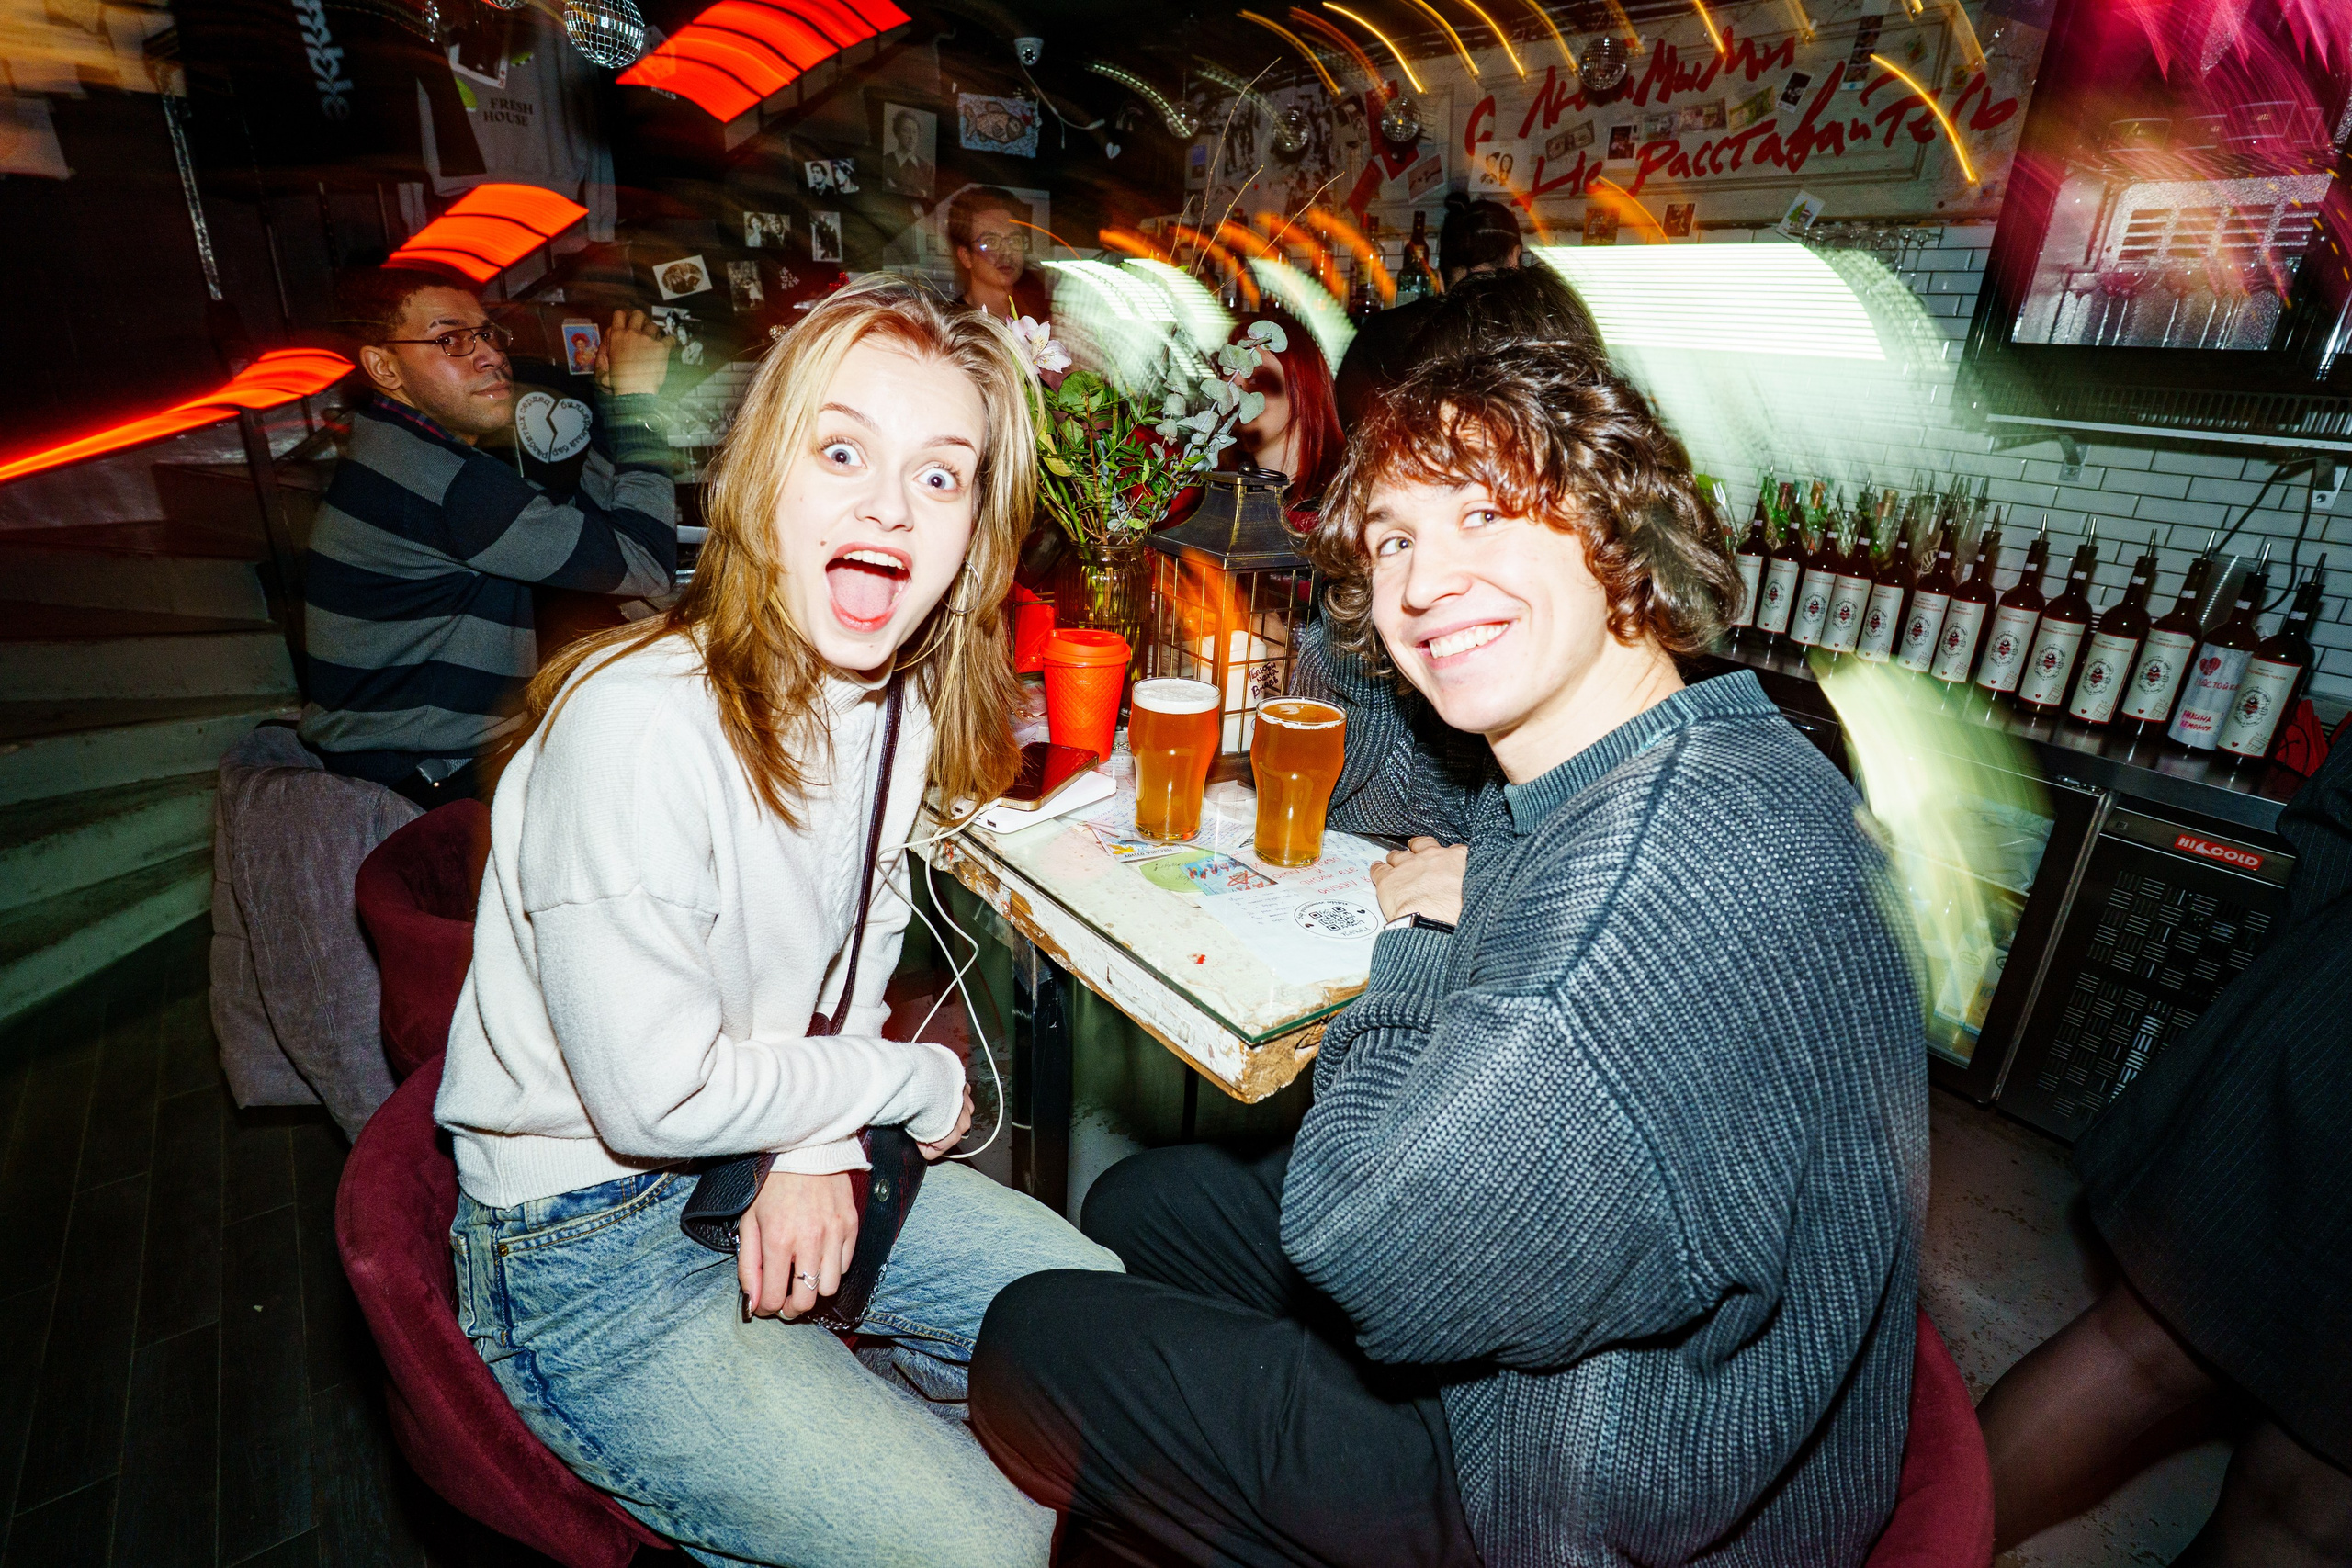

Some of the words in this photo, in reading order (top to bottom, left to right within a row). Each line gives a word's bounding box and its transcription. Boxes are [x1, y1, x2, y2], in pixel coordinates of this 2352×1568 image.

[490, 97, 533, 115] FRESH
[483, 110, 528, 126] HOUSE
[519, 396, 551, 413] сердец
[518, 416, 548, 459] разбитых
[1338, 866, 1359, 874] ЭТУ
[1317, 879, 1358, 895] ЛЮБЛЮ
